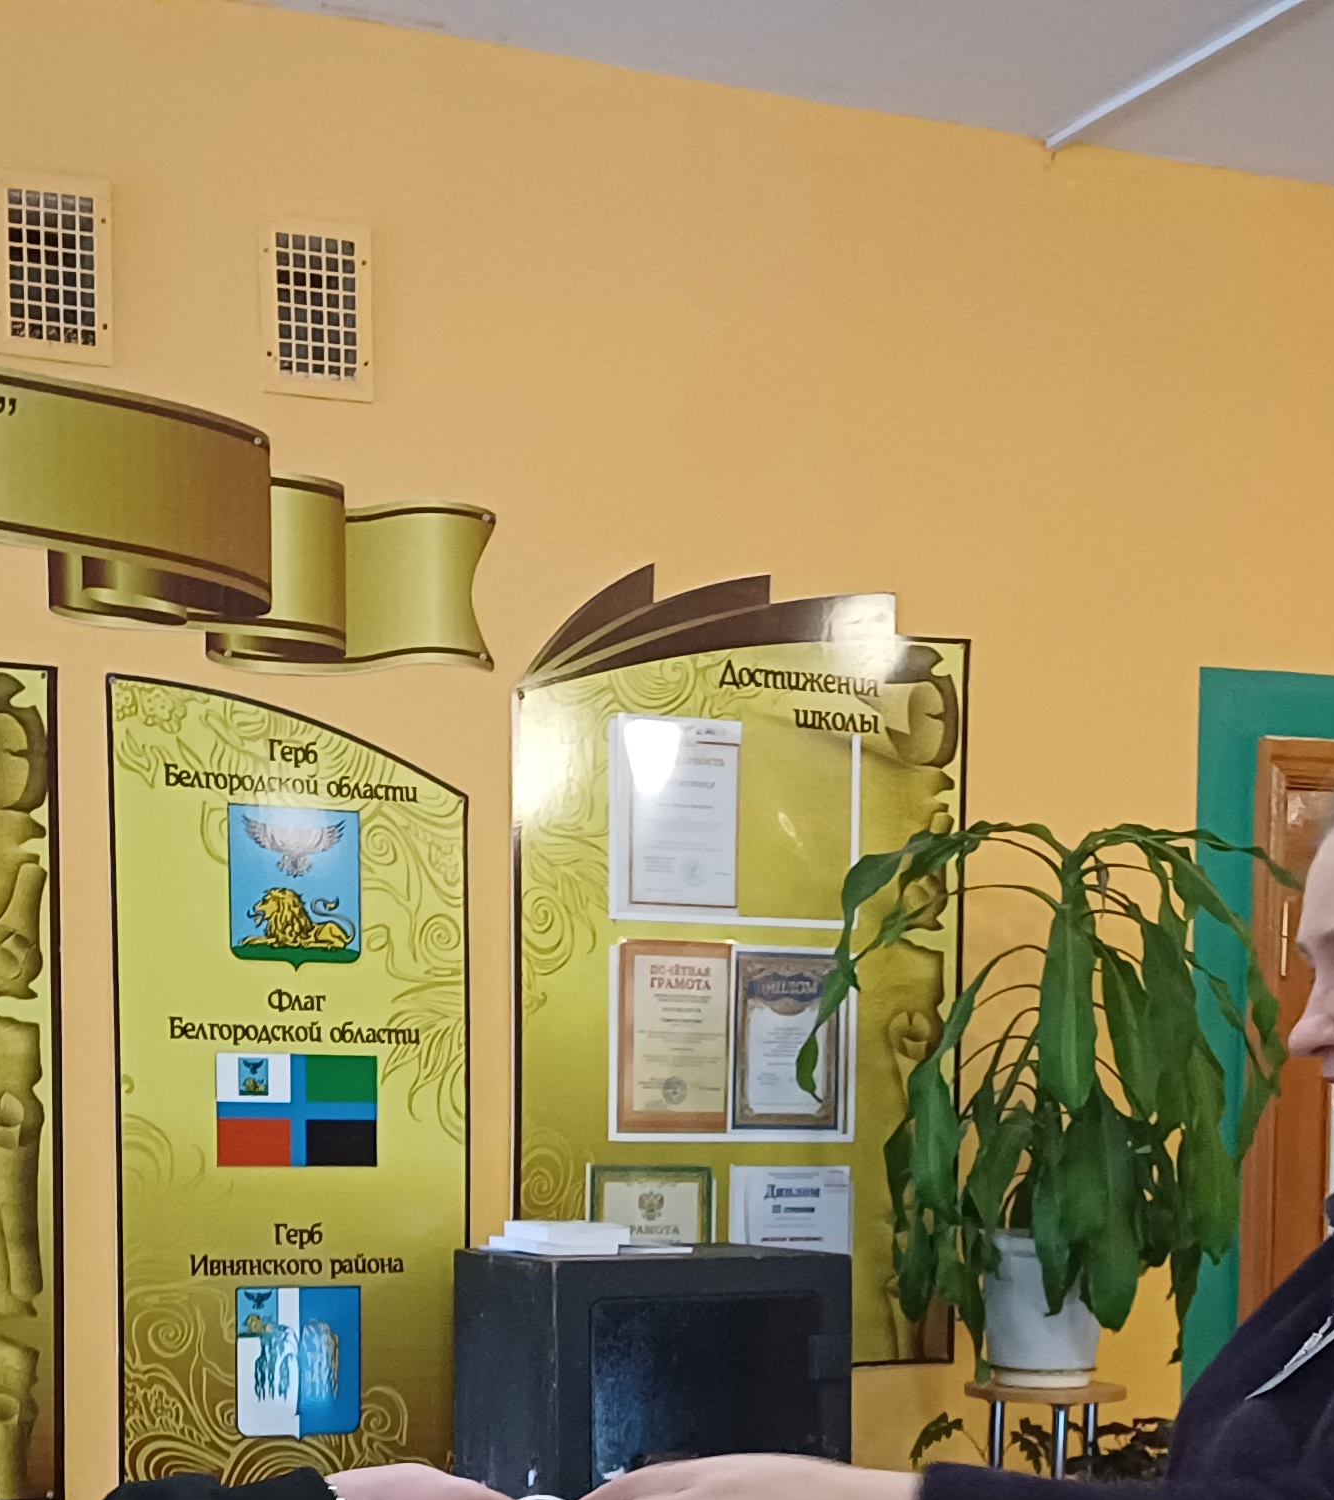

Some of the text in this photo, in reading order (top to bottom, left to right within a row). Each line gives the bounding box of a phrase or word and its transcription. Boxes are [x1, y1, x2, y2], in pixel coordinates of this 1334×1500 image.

[719, 659, 880, 697] Достижения
[793, 708, 880, 734] школы
[268, 739, 318, 768] Герб
[164, 763, 418, 803] Белгородской области
[649, 977, 712, 991] ГРАМОТА
[267, 989, 327, 1012] Флаг
[169, 1016, 421, 1046] Белгородской области
[274, 1223, 323, 1249] Герб
[629, 1224, 681, 1236] РАМОТА
[190, 1254, 405, 1278] Ивнянского района
